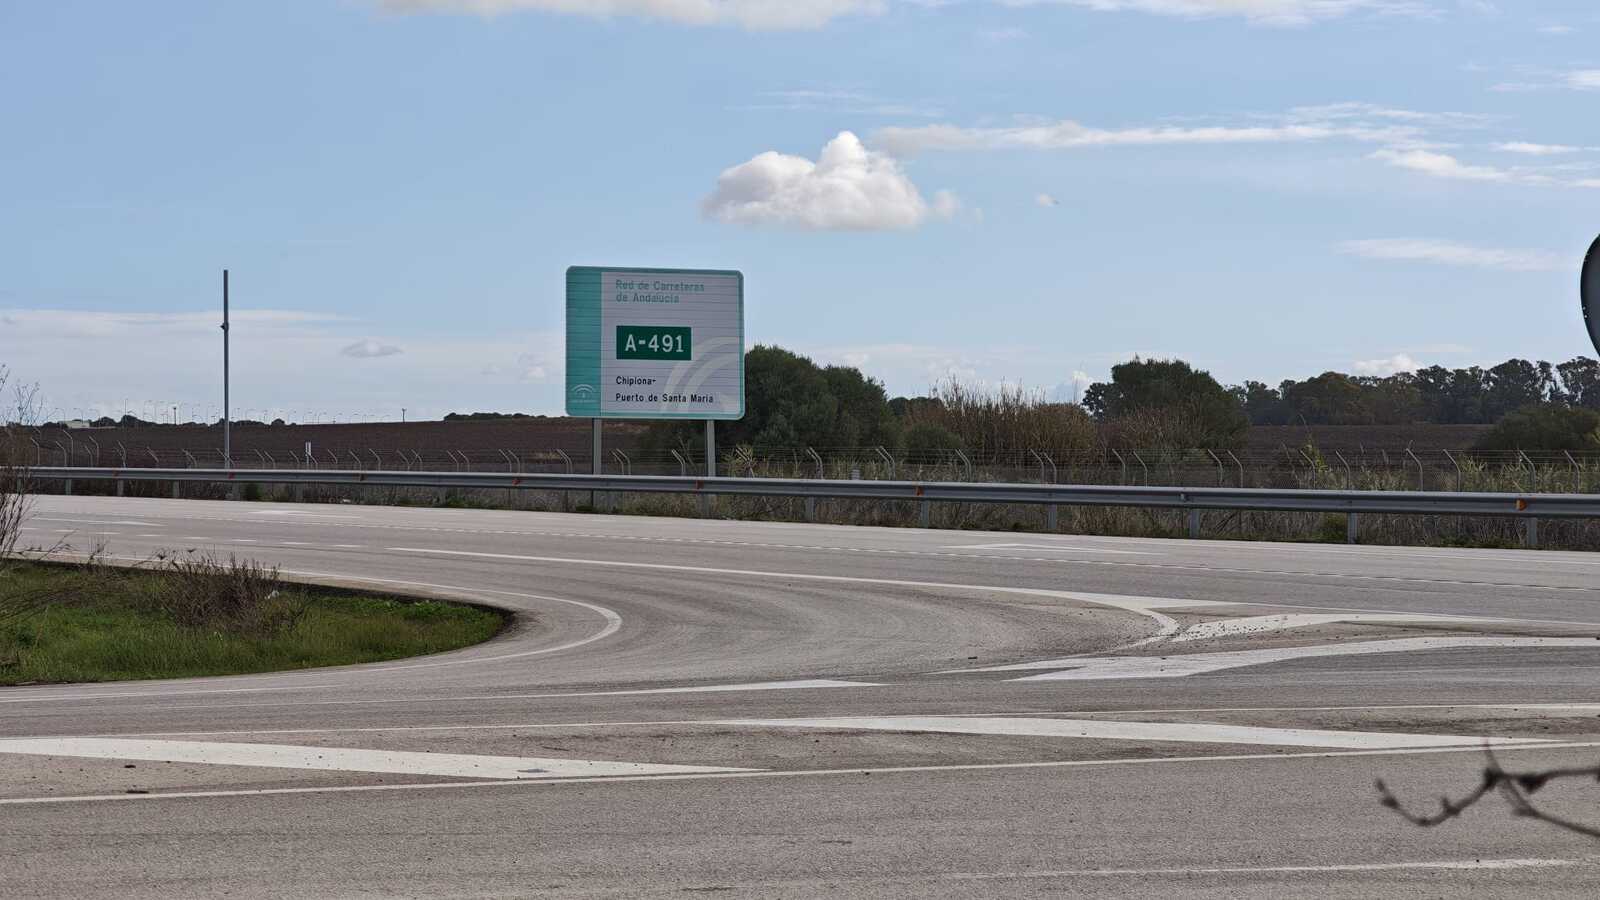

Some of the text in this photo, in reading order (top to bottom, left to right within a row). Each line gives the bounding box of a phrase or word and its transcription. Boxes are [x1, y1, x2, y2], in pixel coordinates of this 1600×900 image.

[615, 279, 705, 292] Red de Carreteras
[616, 293, 628, 302] de
[625, 334, 684, 353] A-491
[616, 393, 645, 402] Puerto
[648, 394, 658, 402] de
[662, 394, 687, 403] Santa
